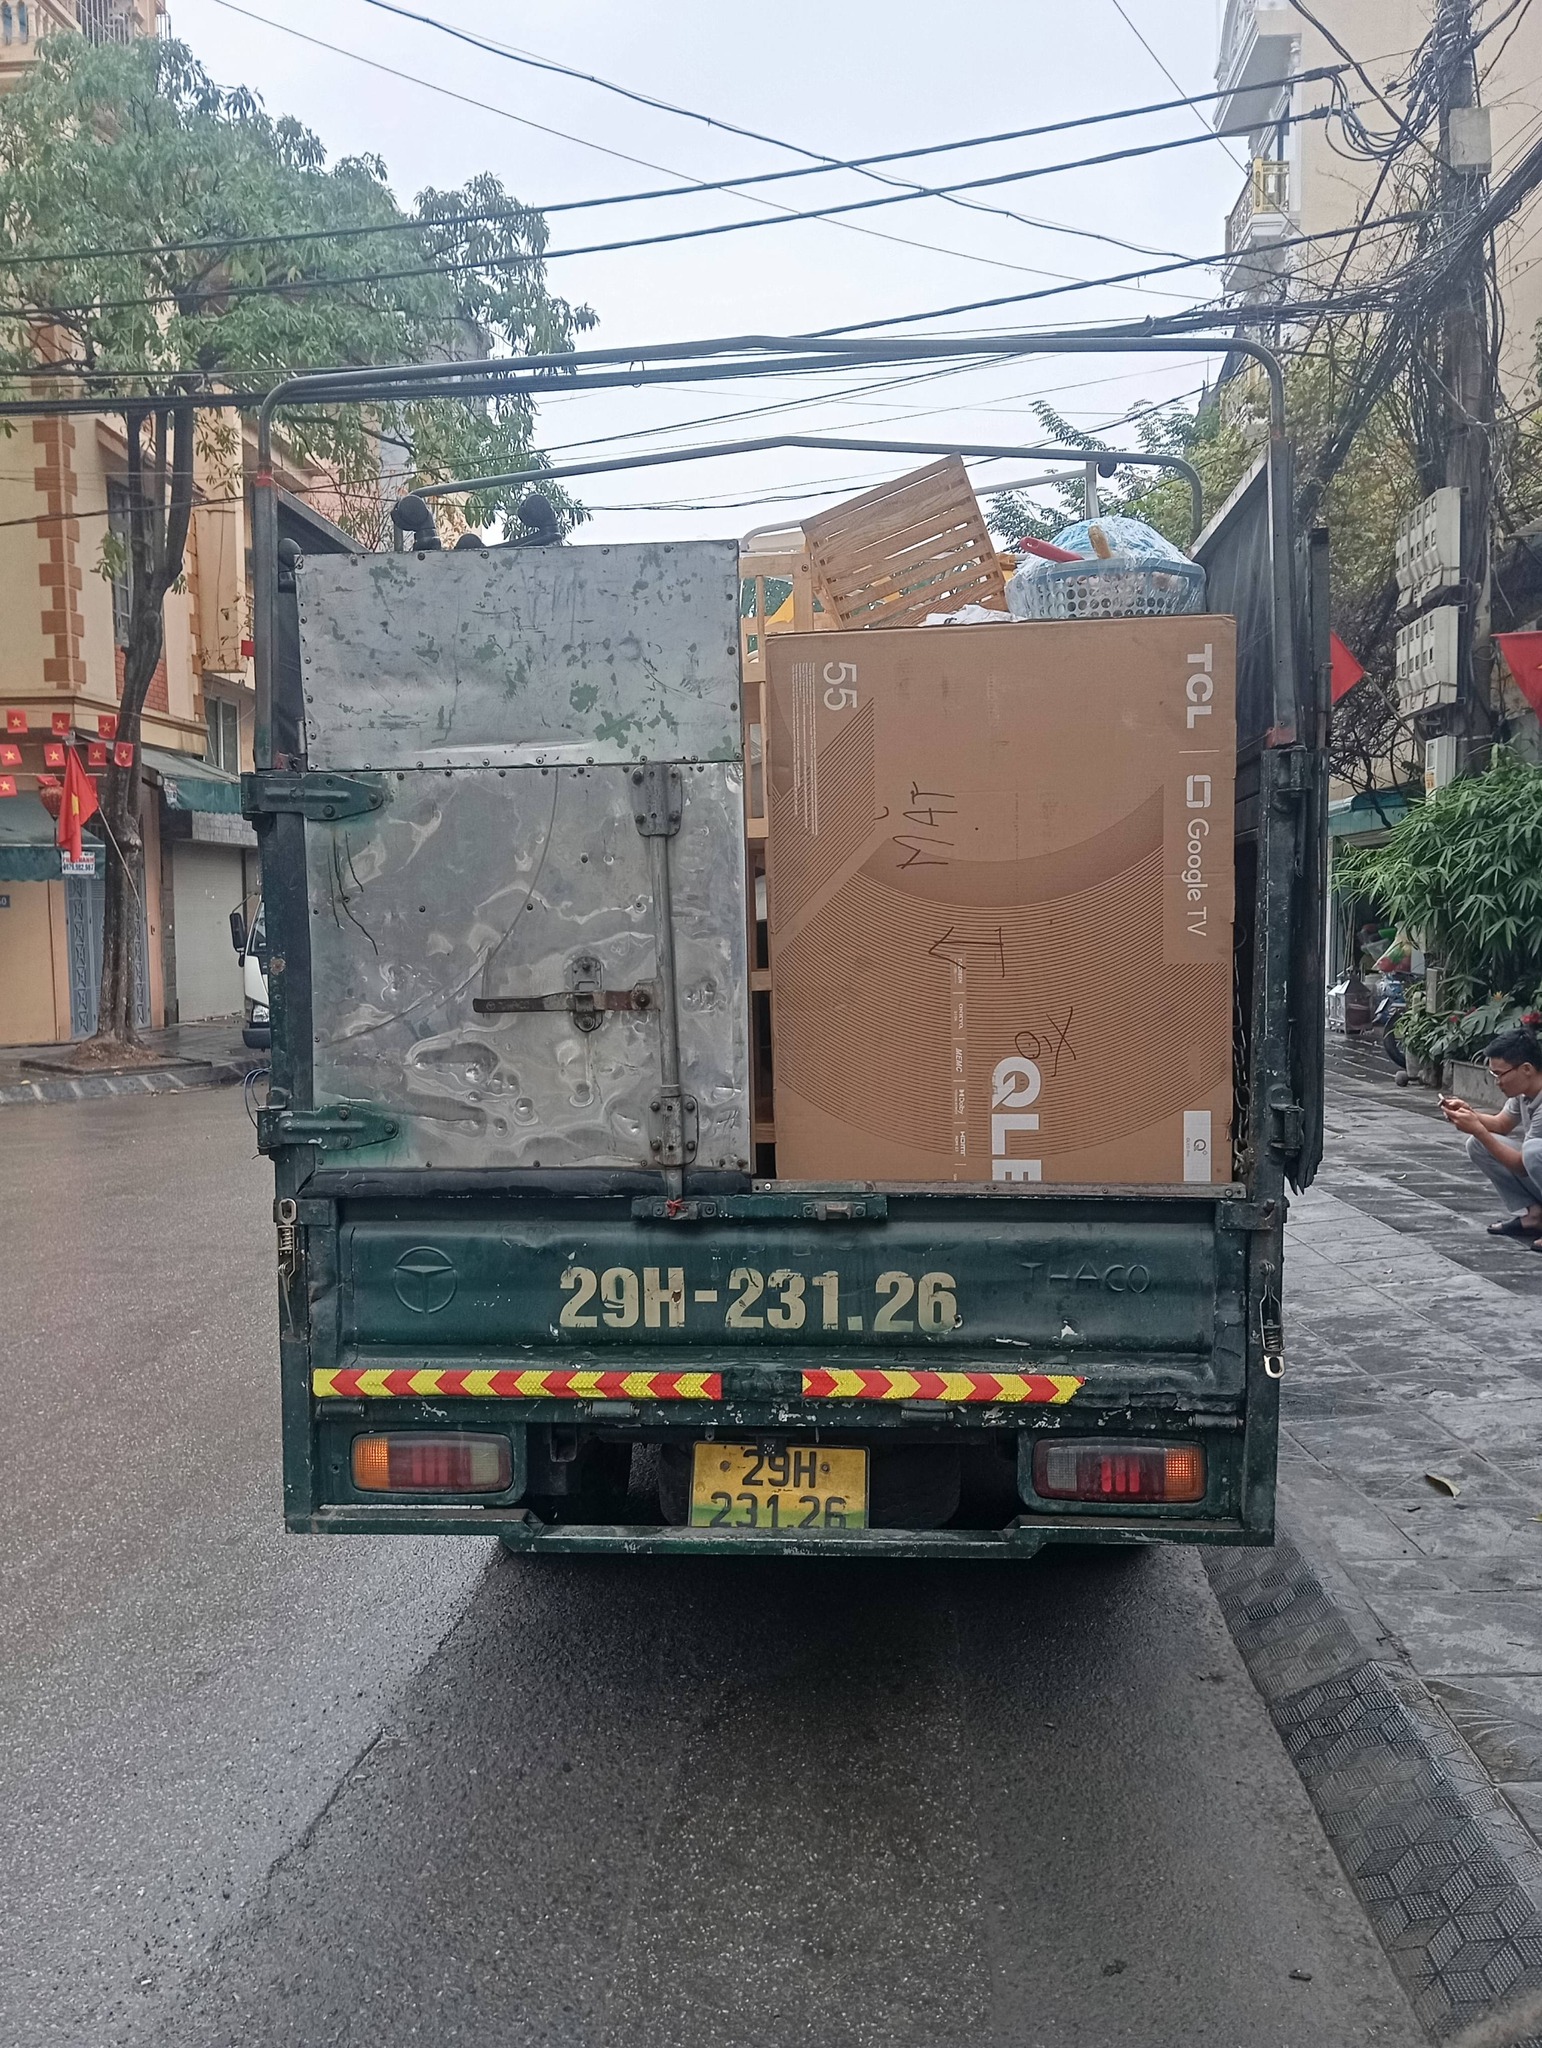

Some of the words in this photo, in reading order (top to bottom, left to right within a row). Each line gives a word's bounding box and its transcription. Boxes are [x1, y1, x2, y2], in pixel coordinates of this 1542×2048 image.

[823, 661, 858, 711] 55
[1185, 643, 1214, 729] TCL
[1181, 818, 1210, 902] Google
[1186, 906, 1207, 937] TV
[955, 1047, 963, 1073] MEMC
[958, 1096, 966, 1115] Dolby
[559, 1266, 959, 1334] 29H-231.26
[742, 1448, 817, 1489] 29H
[709, 1491, 847, 1529] 231.26
